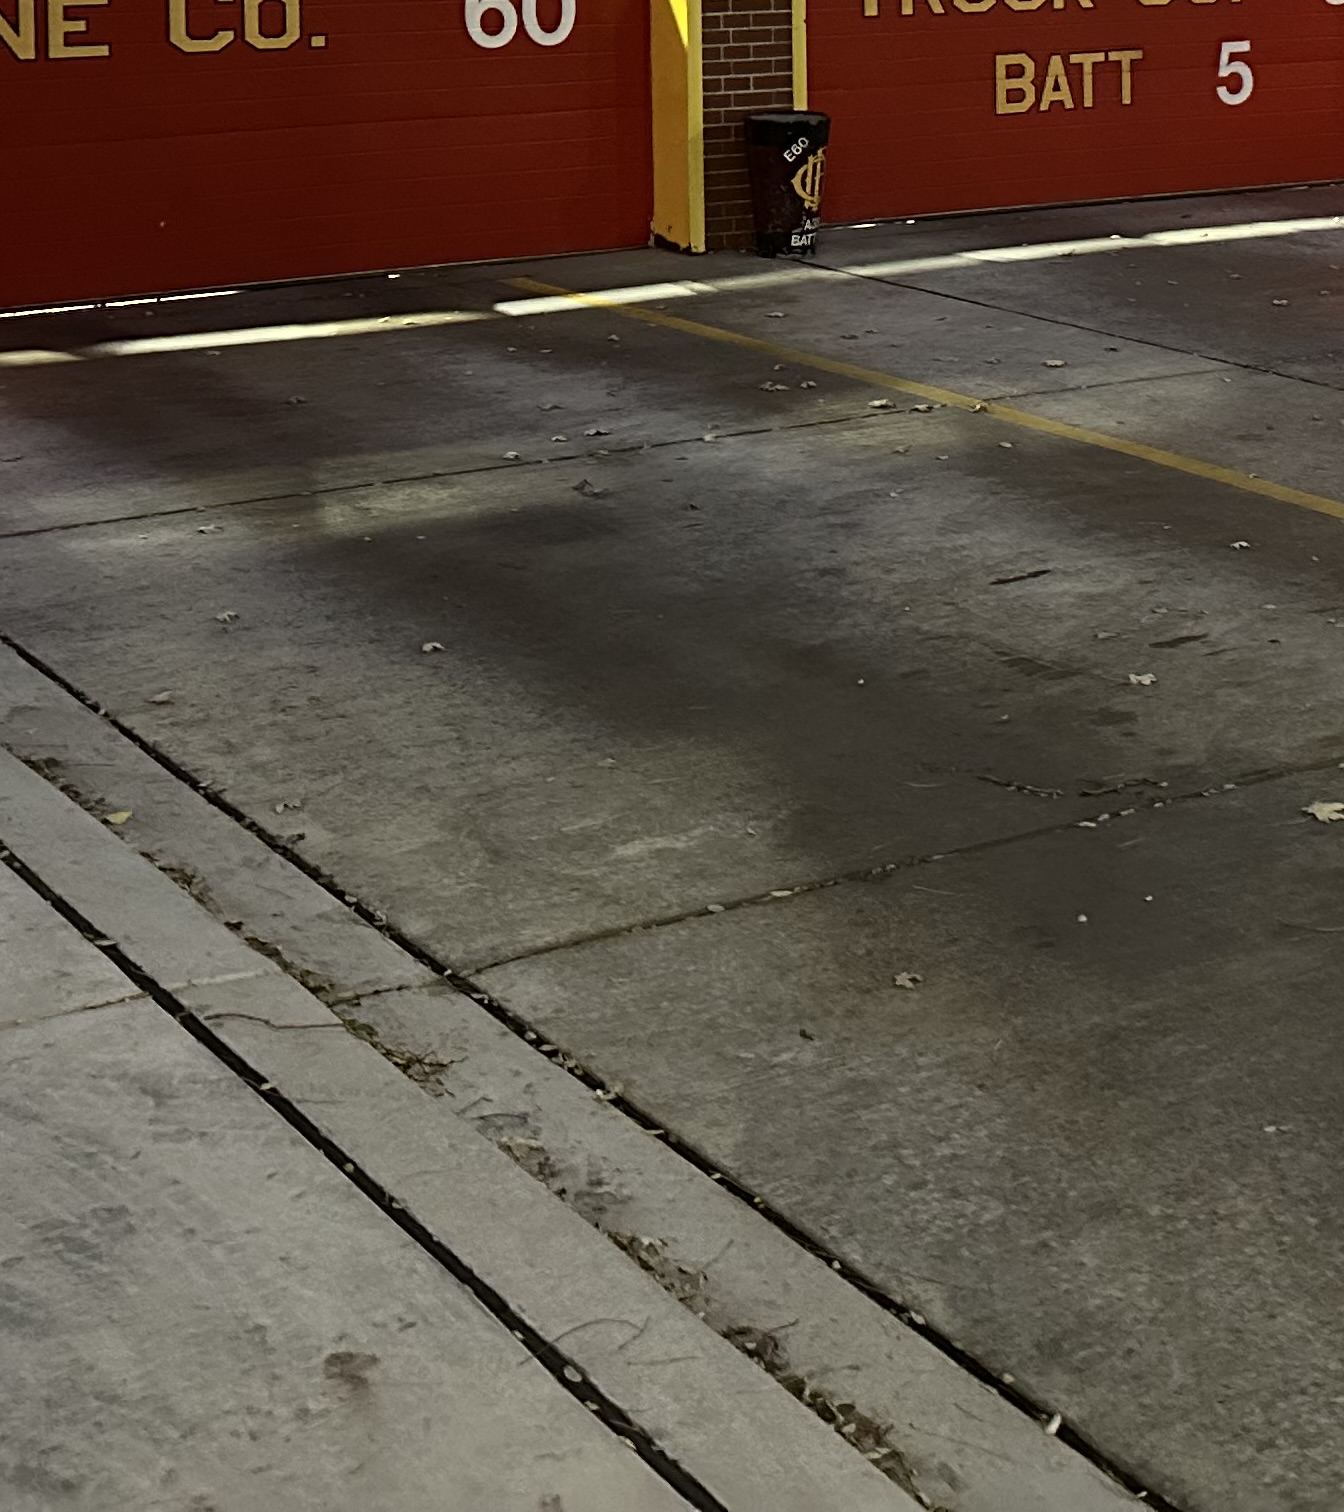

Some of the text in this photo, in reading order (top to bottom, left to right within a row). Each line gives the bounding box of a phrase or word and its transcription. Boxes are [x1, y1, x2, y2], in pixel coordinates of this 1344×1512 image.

[995, 40, 1254, 115] BATT 5
[783, 136, 810, 163] E60
